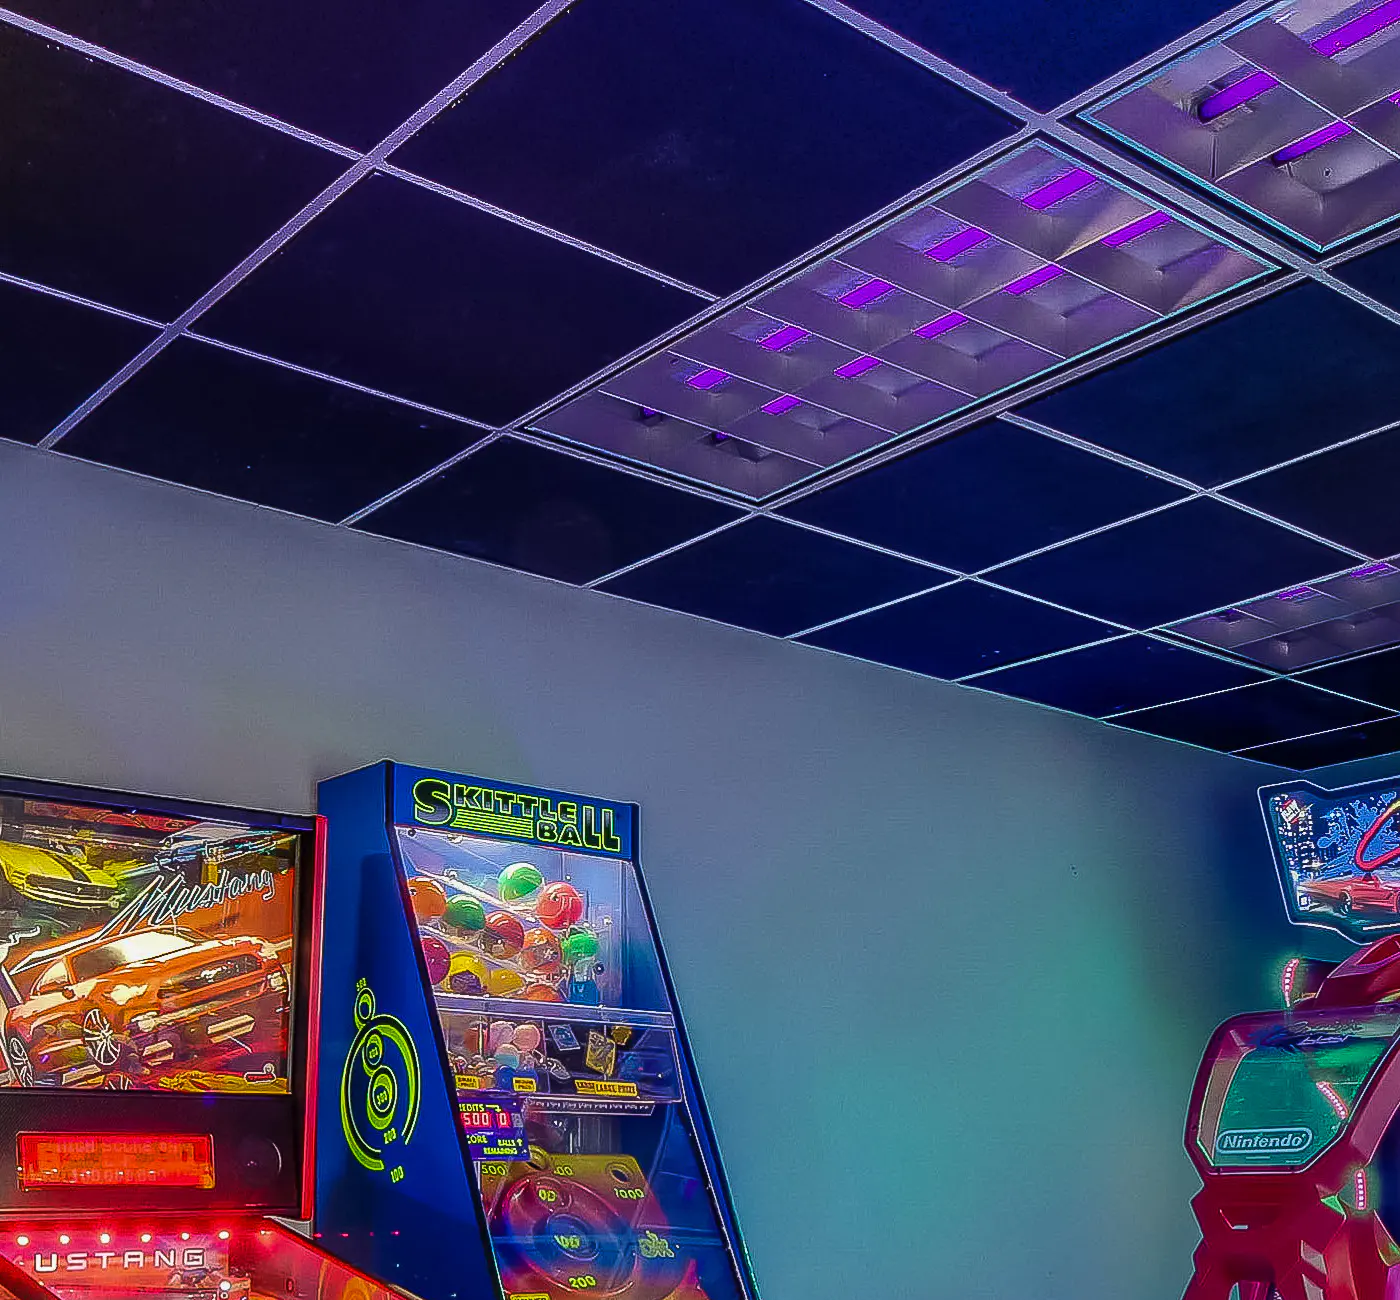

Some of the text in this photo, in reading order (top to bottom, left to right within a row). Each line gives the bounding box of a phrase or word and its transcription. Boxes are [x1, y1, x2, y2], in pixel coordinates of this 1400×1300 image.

[413, 778, 577, 825] SKITTLE
[536, 805, 621, 852] BALL
[1223, 1133, 1303, 1149] Nintendo
[481, 1164, 507, 1176] 500
[613, 1187, 645, 1199] 1000
[34, 1248, 205, 1272] USTANG
[568, 1275, 597, 1289] 200
